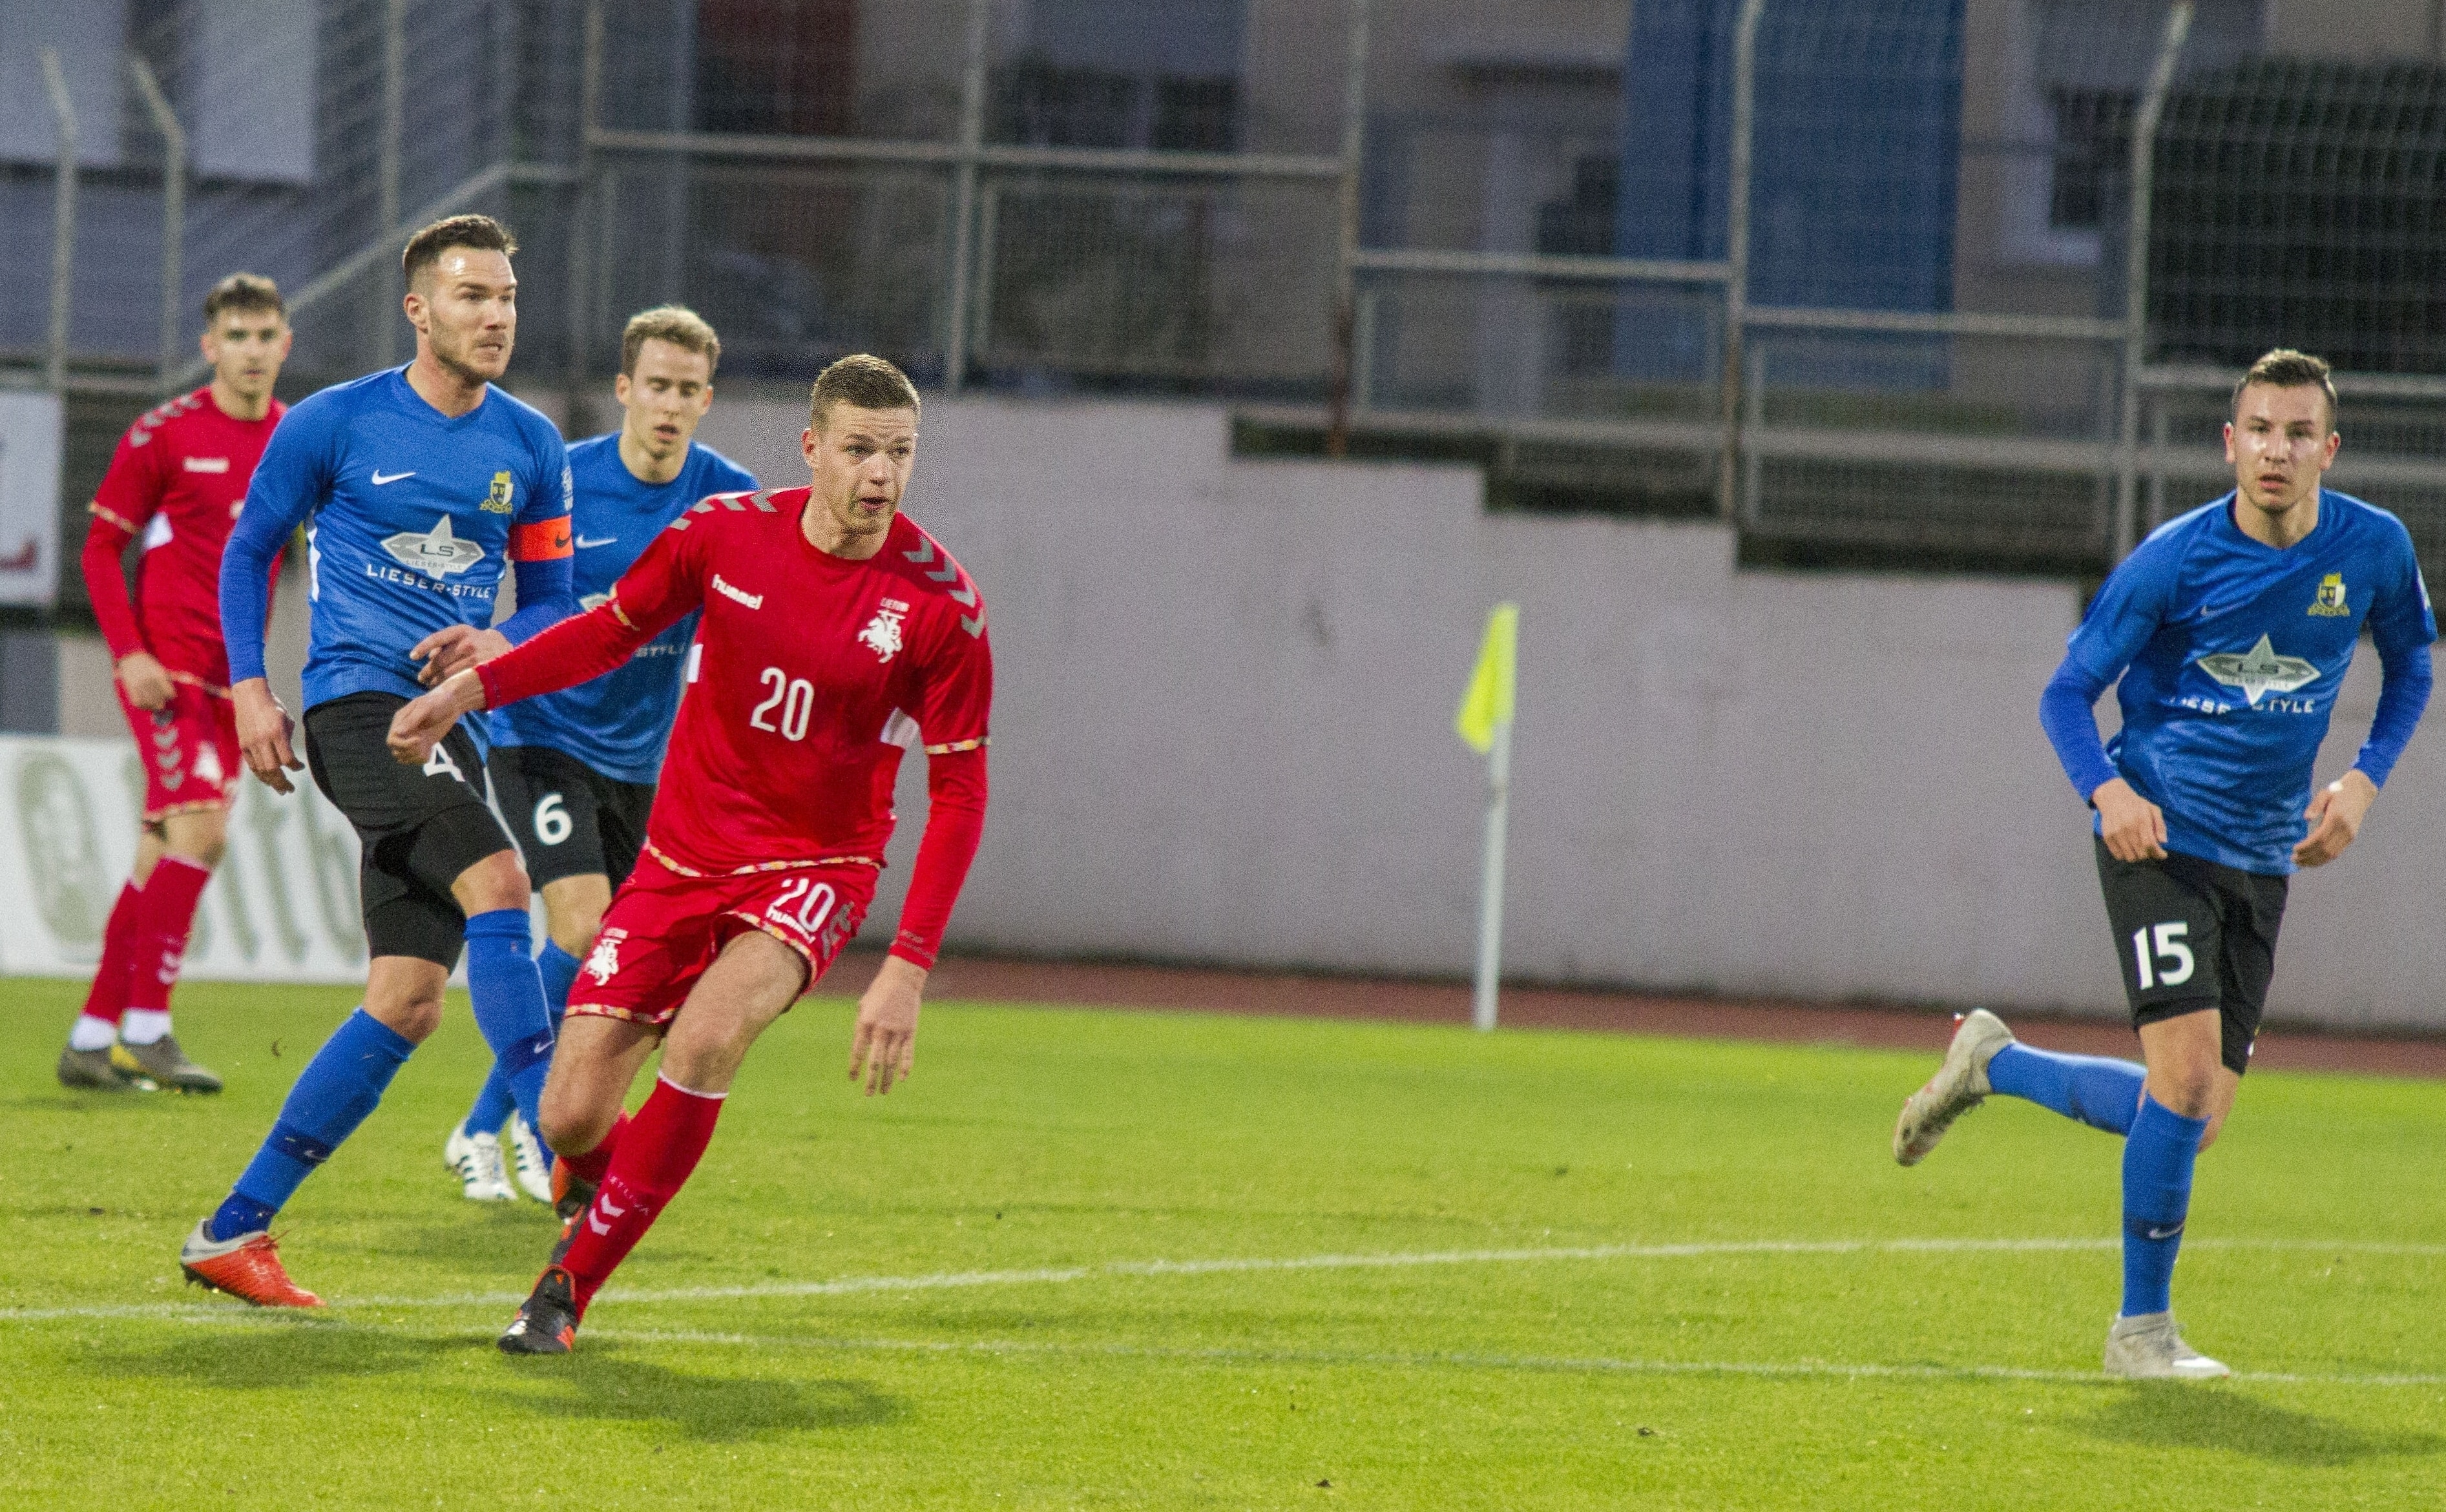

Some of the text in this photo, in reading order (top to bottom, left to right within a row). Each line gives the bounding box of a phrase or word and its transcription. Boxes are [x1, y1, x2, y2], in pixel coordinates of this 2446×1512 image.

[421, 543, 454, 557] LS
[366, 563, 492, 599] LIESER-STYLE
[711, 574, 764, 610] hummel
[750, 667, 815, 741] 20
[423, 741, 465, 782] 4
[535, 792, 573, 845] 6
[770, 878, 836, 932] 20
[2133, 921, 2195, 990] 15
